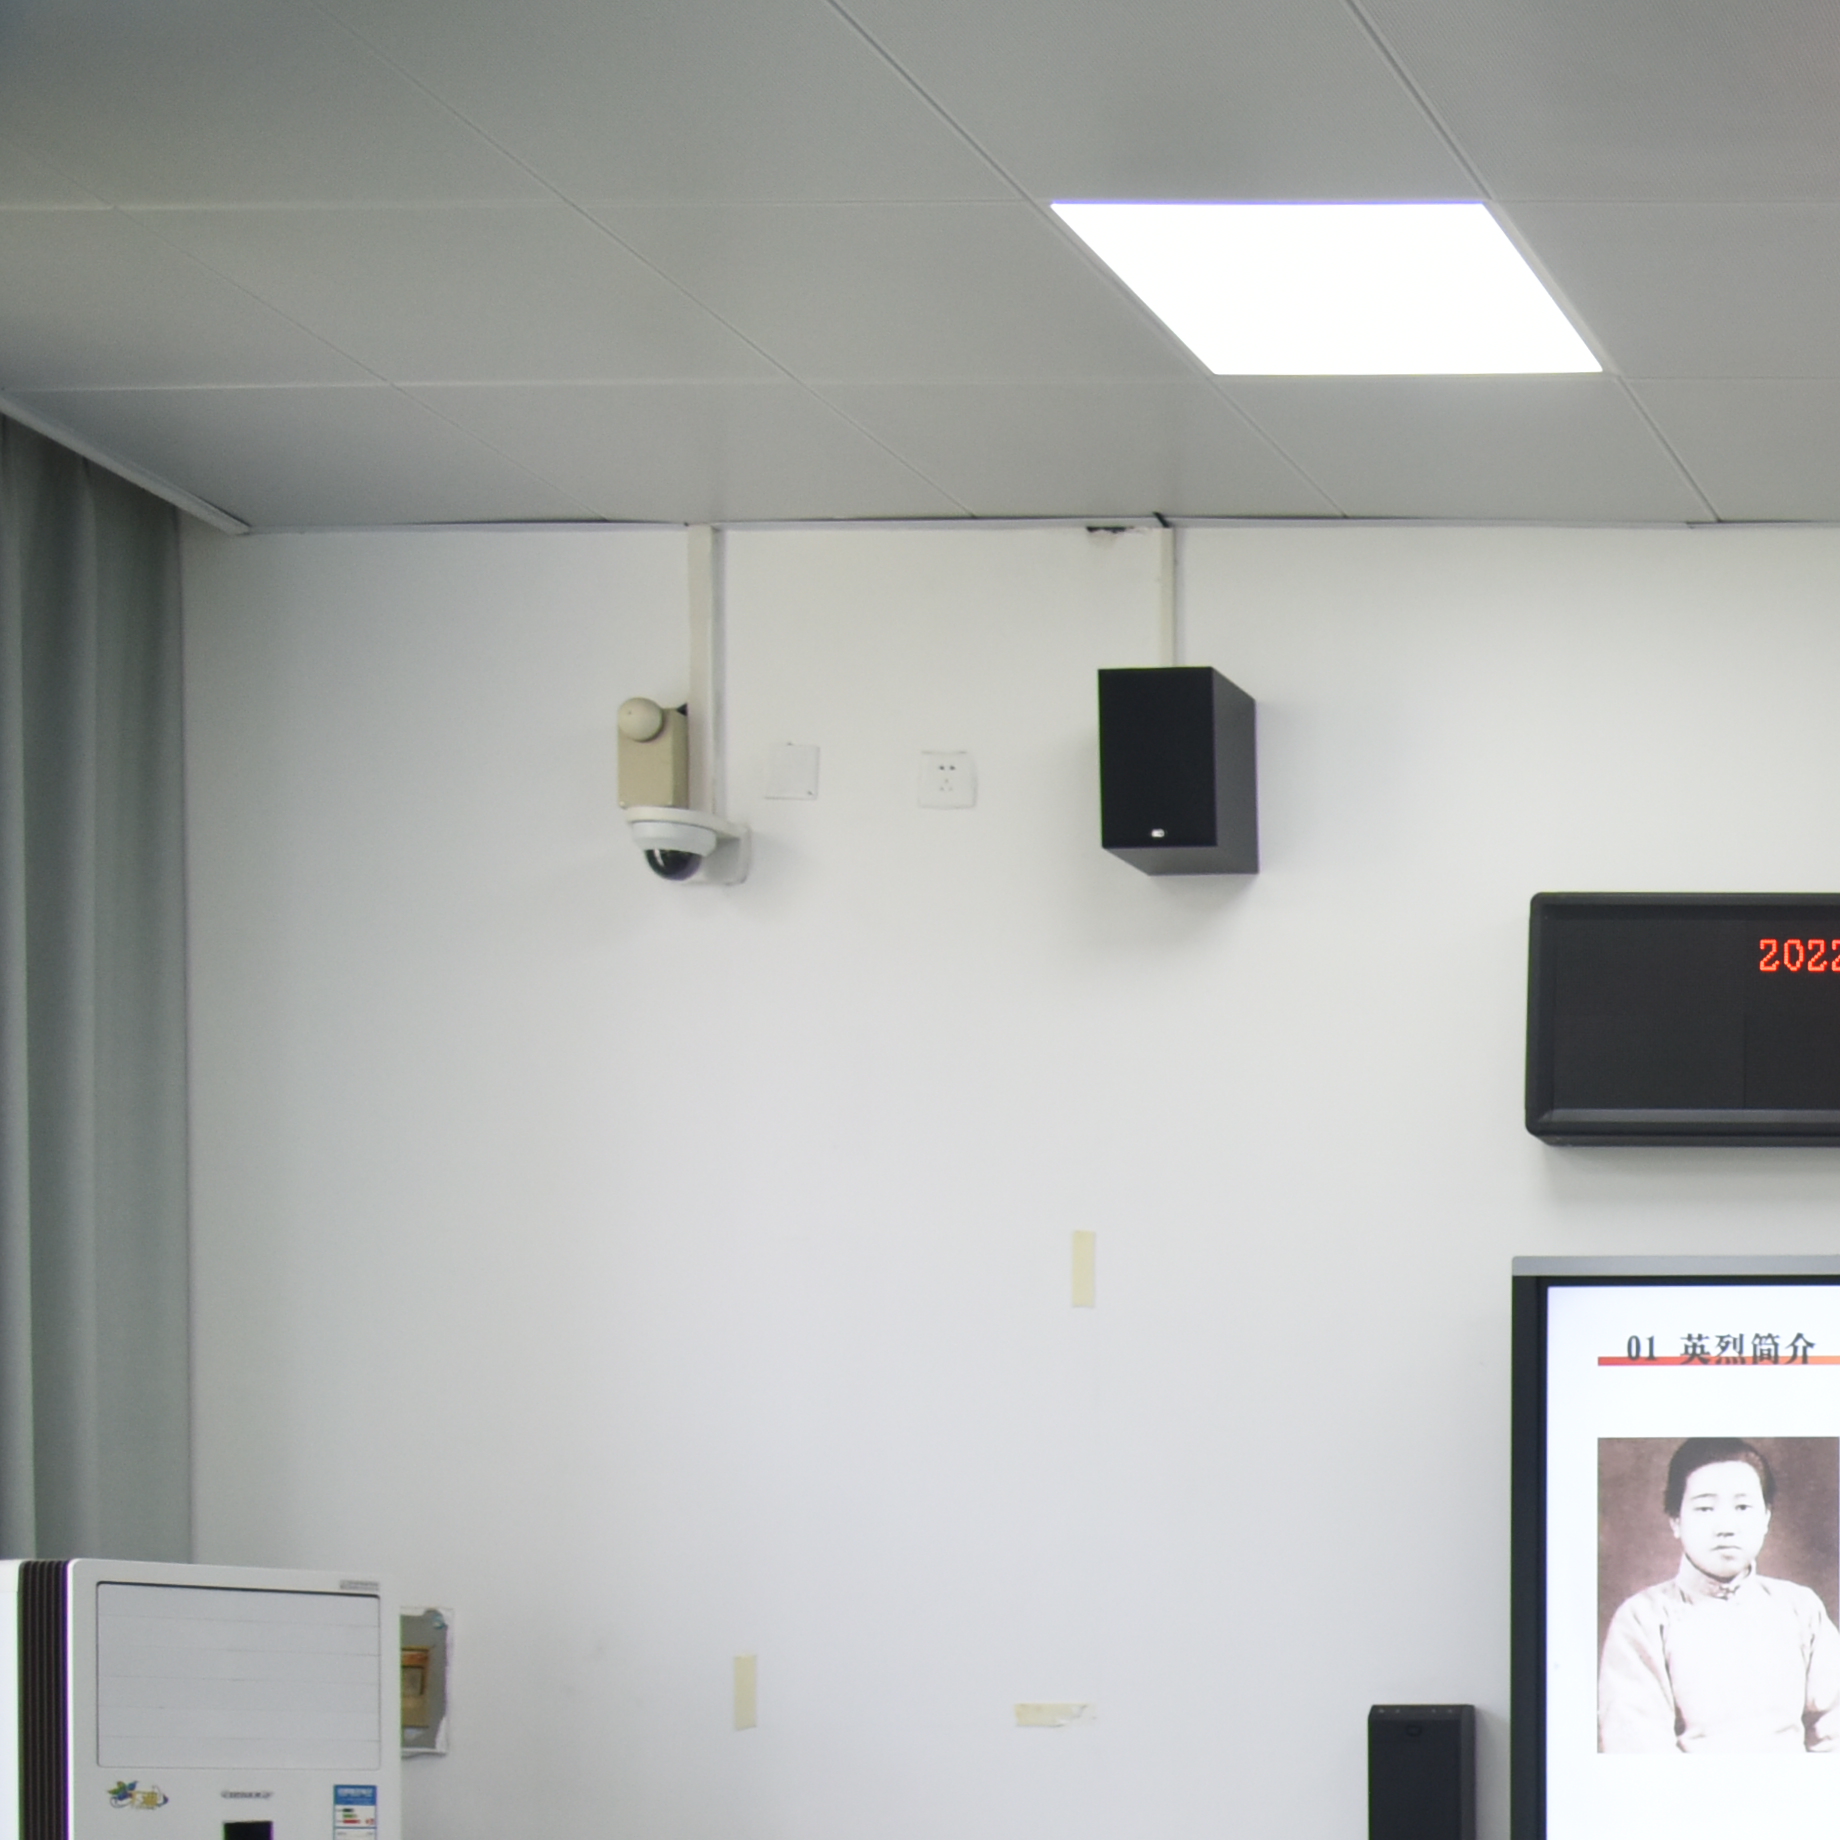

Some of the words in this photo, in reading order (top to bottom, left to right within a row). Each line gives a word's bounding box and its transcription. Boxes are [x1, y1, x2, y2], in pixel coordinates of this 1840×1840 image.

[1627, 1334, 1658, 1361] 01
[1679, 1332, 1816, 1365] 英烈简介
